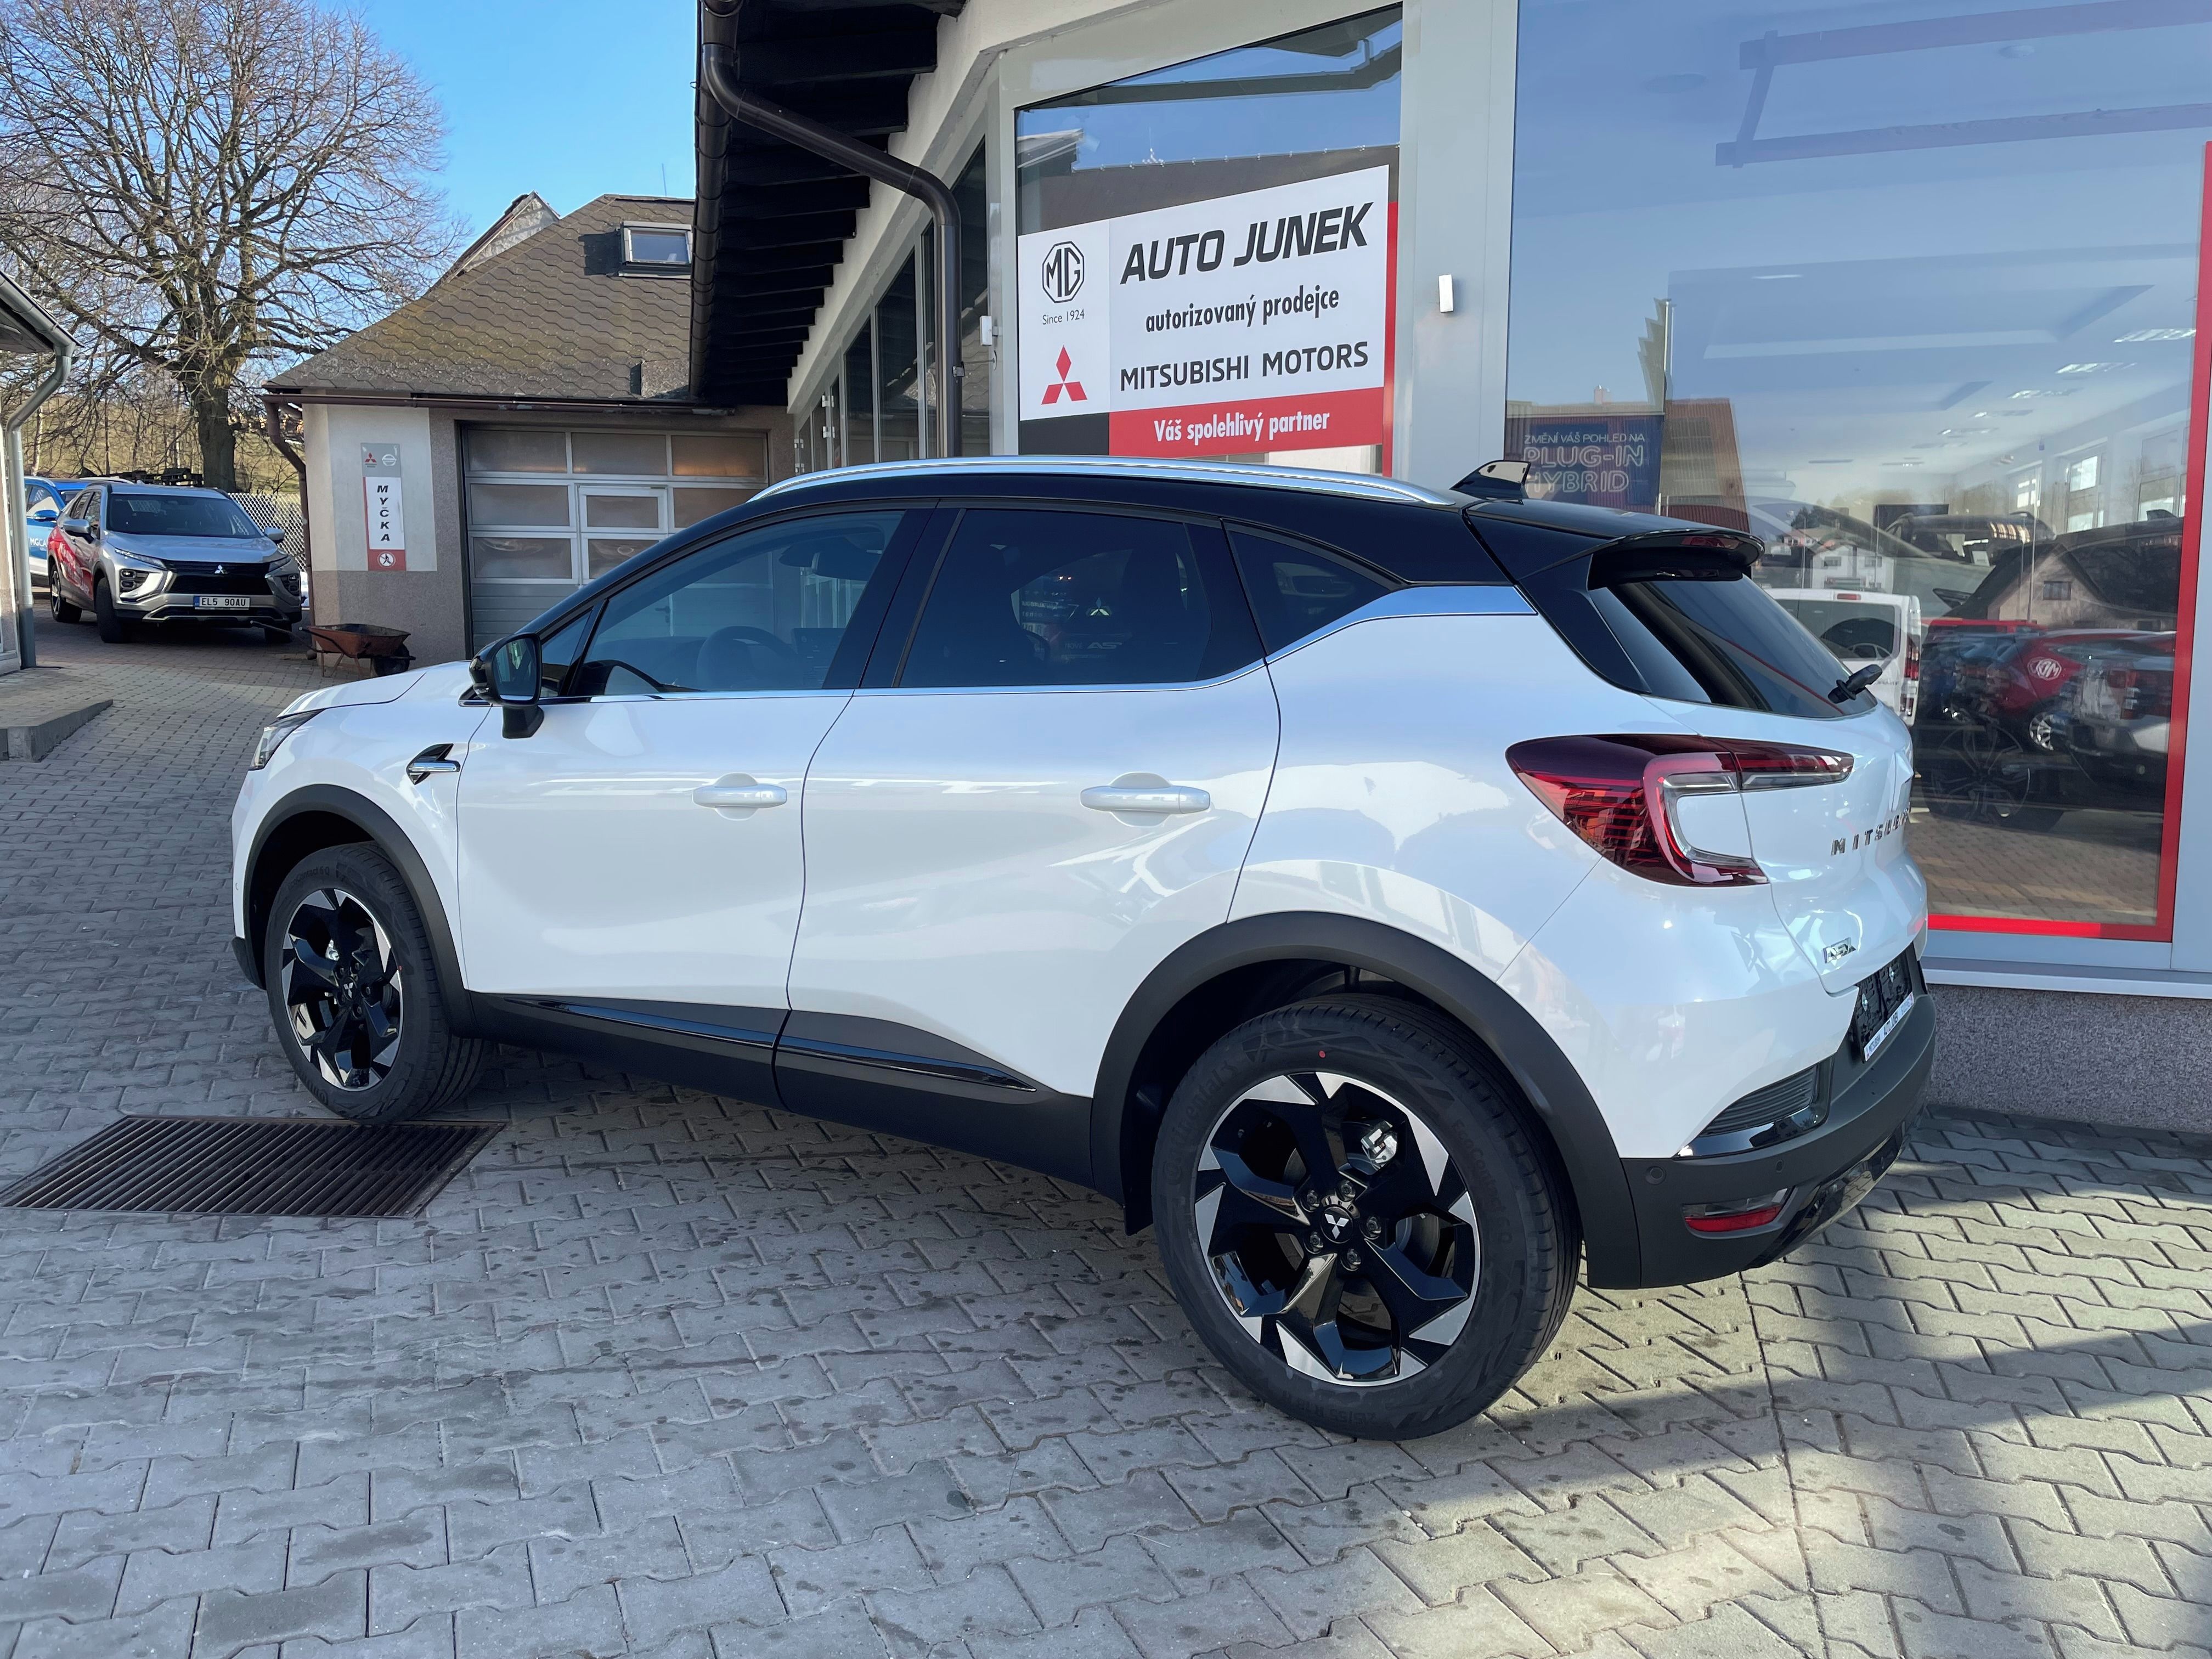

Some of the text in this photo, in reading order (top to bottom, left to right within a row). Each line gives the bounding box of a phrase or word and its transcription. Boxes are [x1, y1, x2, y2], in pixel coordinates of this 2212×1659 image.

[1119, 201, 1374, 285] AUTO JUNEK
[1045, 245, 1082, 300] MG
[1042, 308, 1085, 325] Since 1924
[1146, 285, 1339, 332] autorizovaný prodejce
[1120, 341, 1368, 391] MITSUBISHI MOTORS
[1154, 411, 1330, 446] Váš spolehlivý partner
[1524, 431, 1645, 444] ZMĚNÍ VÁŠ POHLED NA
[1523, 444, 1644, 468] PLUG-IN
[201, 597, 218, 606] EL5
